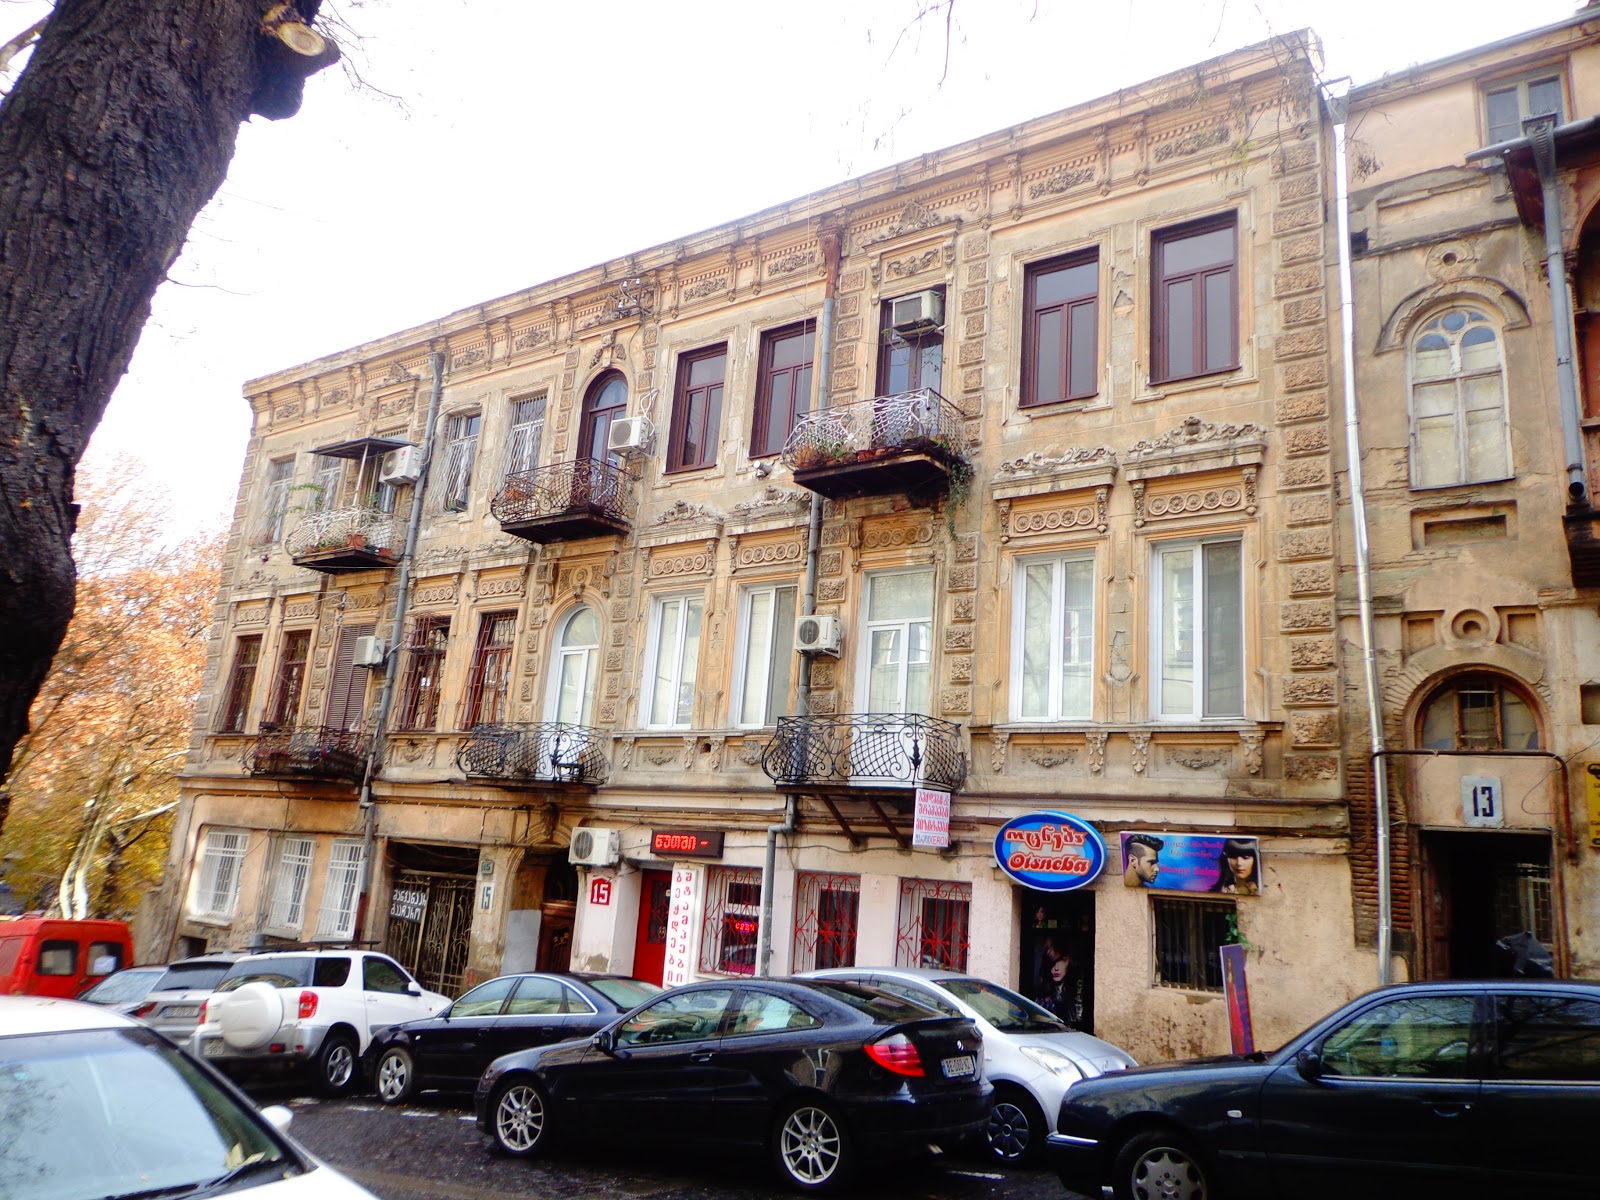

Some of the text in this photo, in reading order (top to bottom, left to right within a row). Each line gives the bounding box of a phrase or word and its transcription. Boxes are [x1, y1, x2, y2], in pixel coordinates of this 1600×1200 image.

[919, 803, 949, 818] შტამპები
[1473, 786, 1494, 817] 13
[1005, 825, 1087, 851] ოცნება
[481, 886, 492, 909] 15
[592, 883, 608, 904] 15
[676, 872, 693, 983] შტამპები
